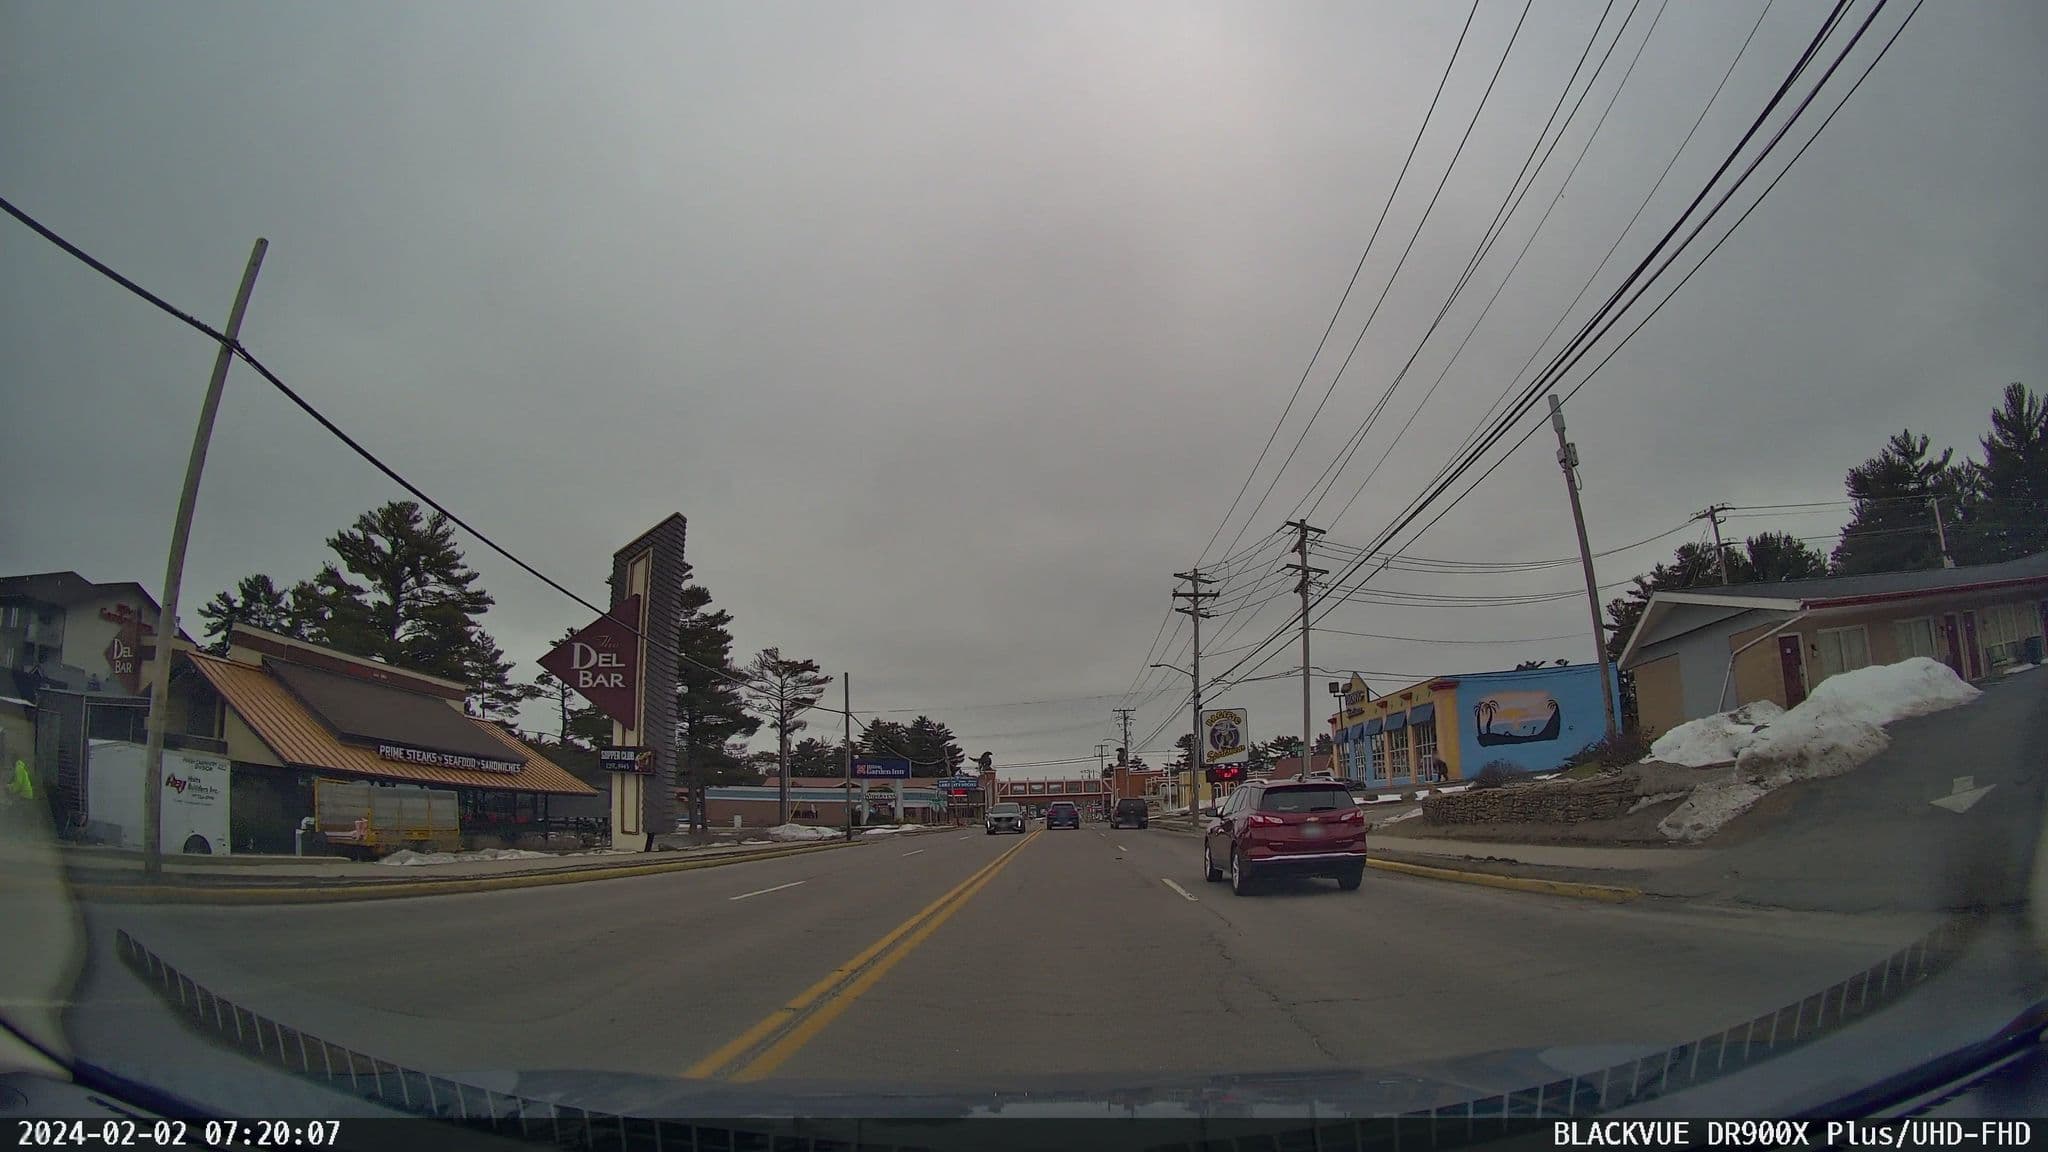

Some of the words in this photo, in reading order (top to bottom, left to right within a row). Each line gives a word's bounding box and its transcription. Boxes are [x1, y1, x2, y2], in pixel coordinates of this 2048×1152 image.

[113, 638, 134, 660] DEL
[571, 642, 626, 670] DEL
[115, 660, 133, 673] BAR
[578, 670, 626, 688] BAR
[379, 744, 404, 759] PRIME
[407, 749, 438, 763] STEAKS
[444, 754, 476, 769] SEAFOOD
[481, 759, 521, 774] SANDWICHES
[601, 750, 620, 760] SUPPER
[621, 751, 635, 761] CLUB
[866, 767, 891, 775] Garden
